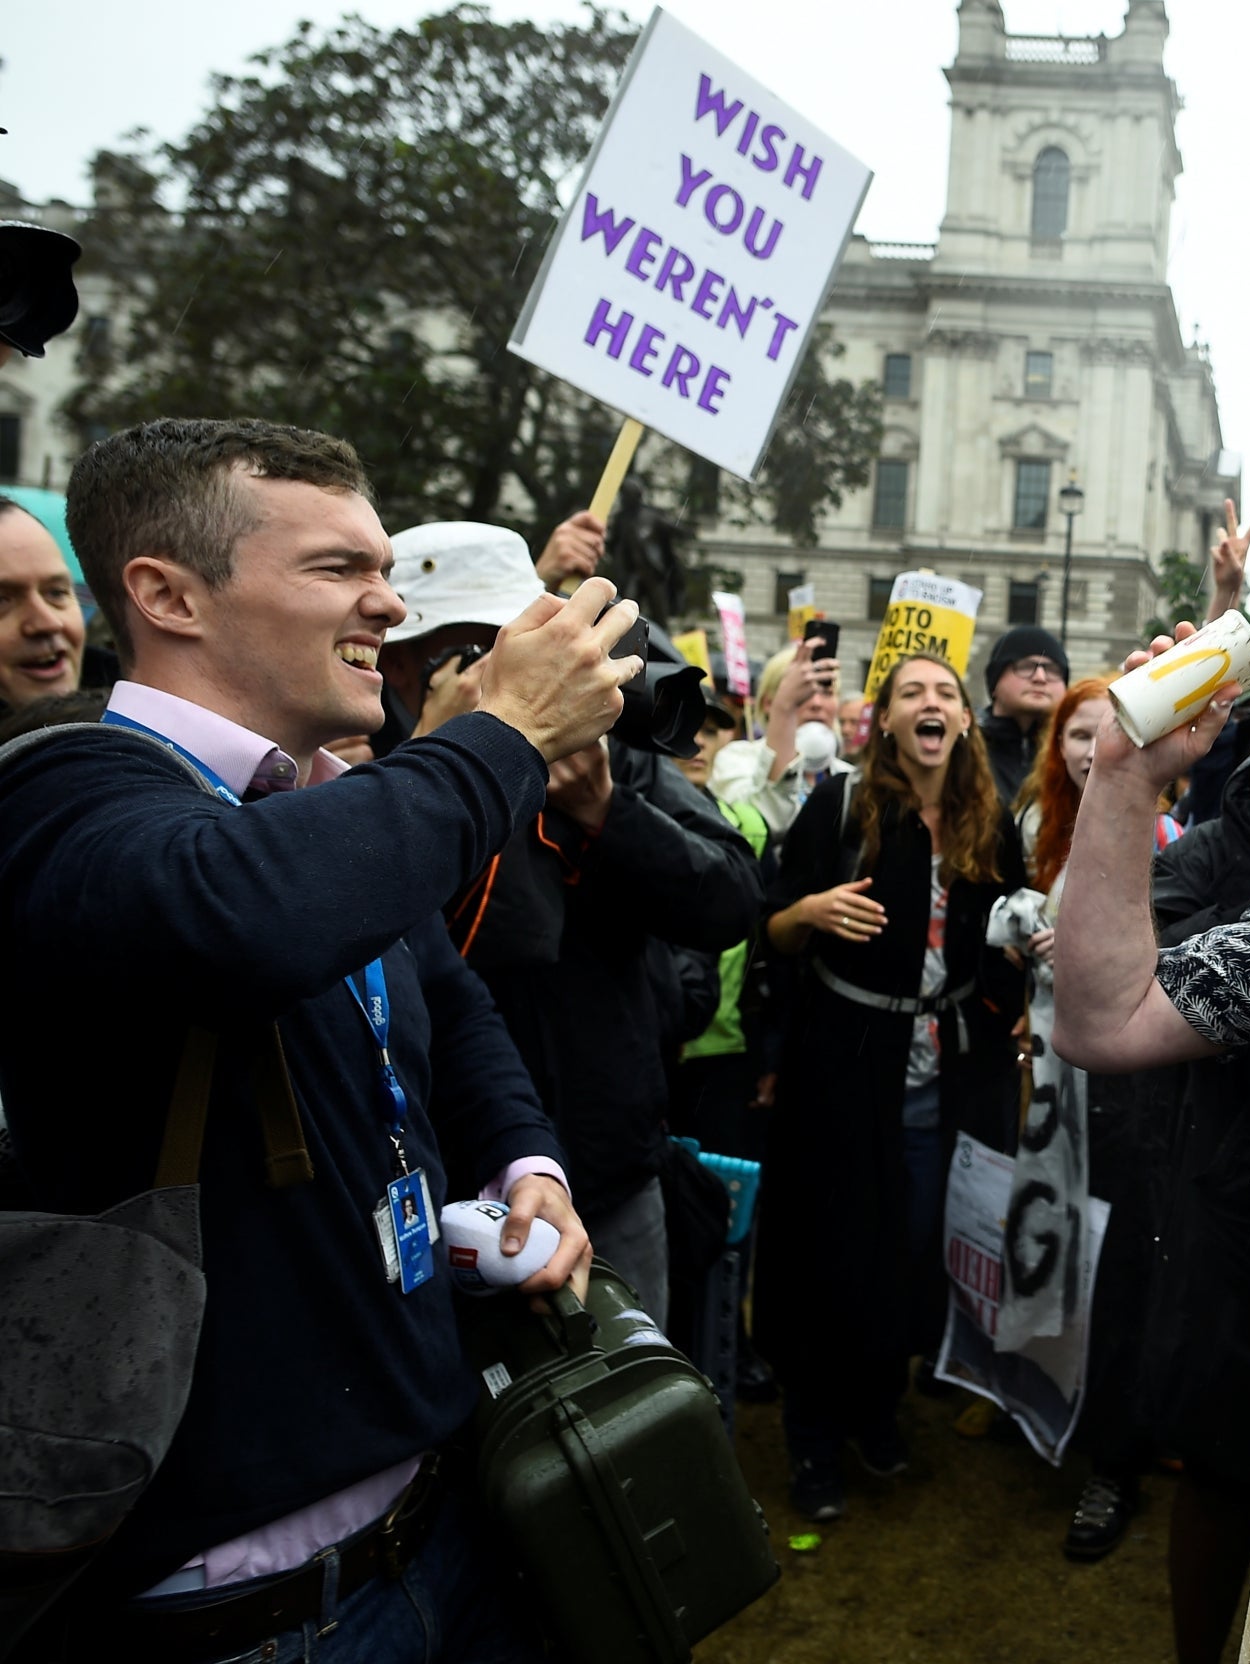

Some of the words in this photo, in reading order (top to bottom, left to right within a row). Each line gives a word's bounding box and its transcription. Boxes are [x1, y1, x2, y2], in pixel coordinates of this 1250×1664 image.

[695, 72, 823, 201] WISH
[675, 153, 784, 261] YOU
[580, 191, 799, 361] WEREN'T
[584, 298, 731, 416] HERE
[905, 606, 932, 629] TO
